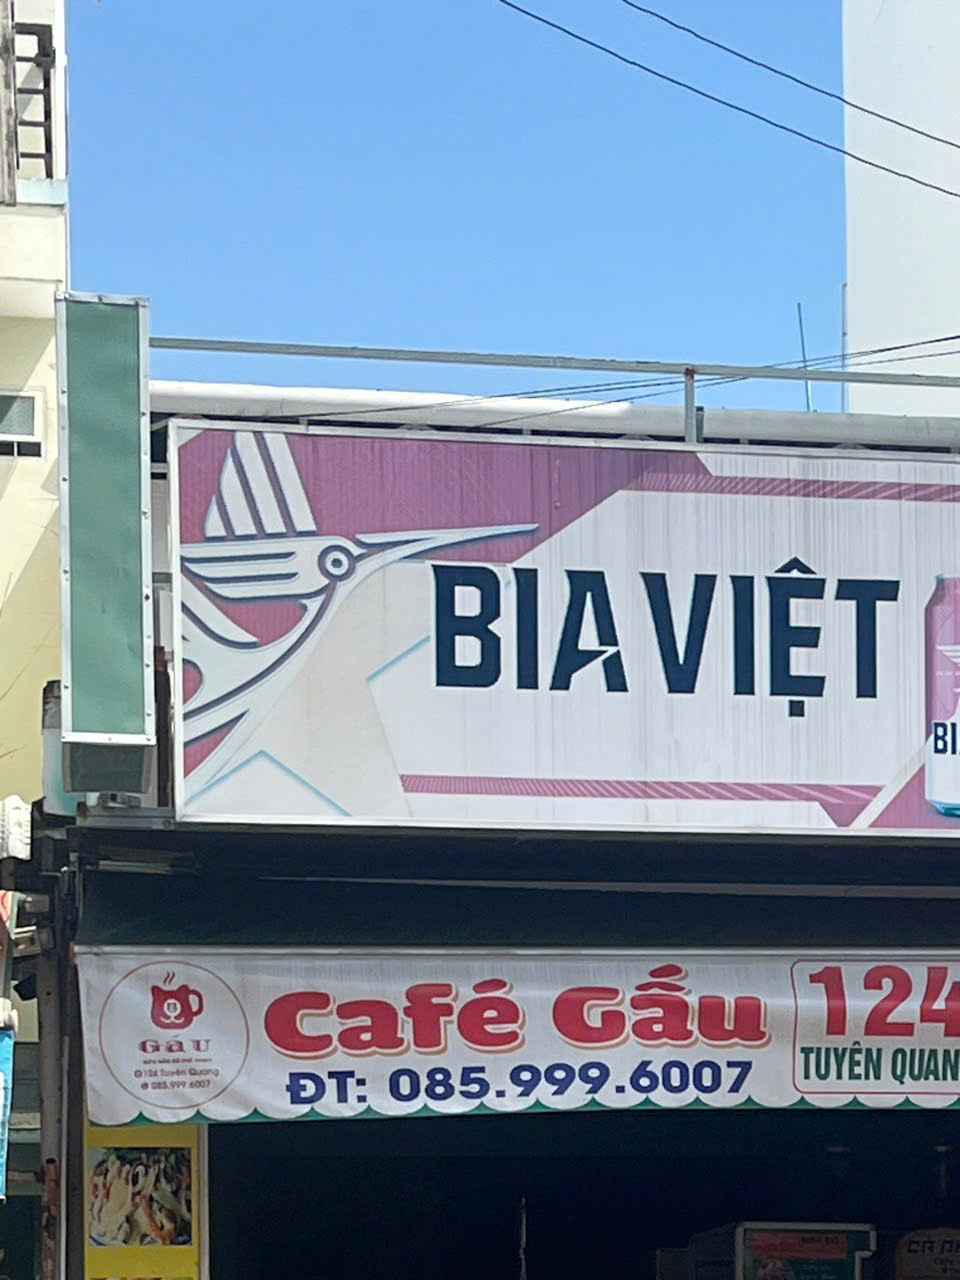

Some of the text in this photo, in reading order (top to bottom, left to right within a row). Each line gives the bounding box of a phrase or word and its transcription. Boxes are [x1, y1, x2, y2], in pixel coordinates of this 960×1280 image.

[263, 978, 524, 1057] Café
[286, 1059, 754, 1105] ĐT: 085.999.6007
[800, 1041, 882, 1080] TUYÊN
